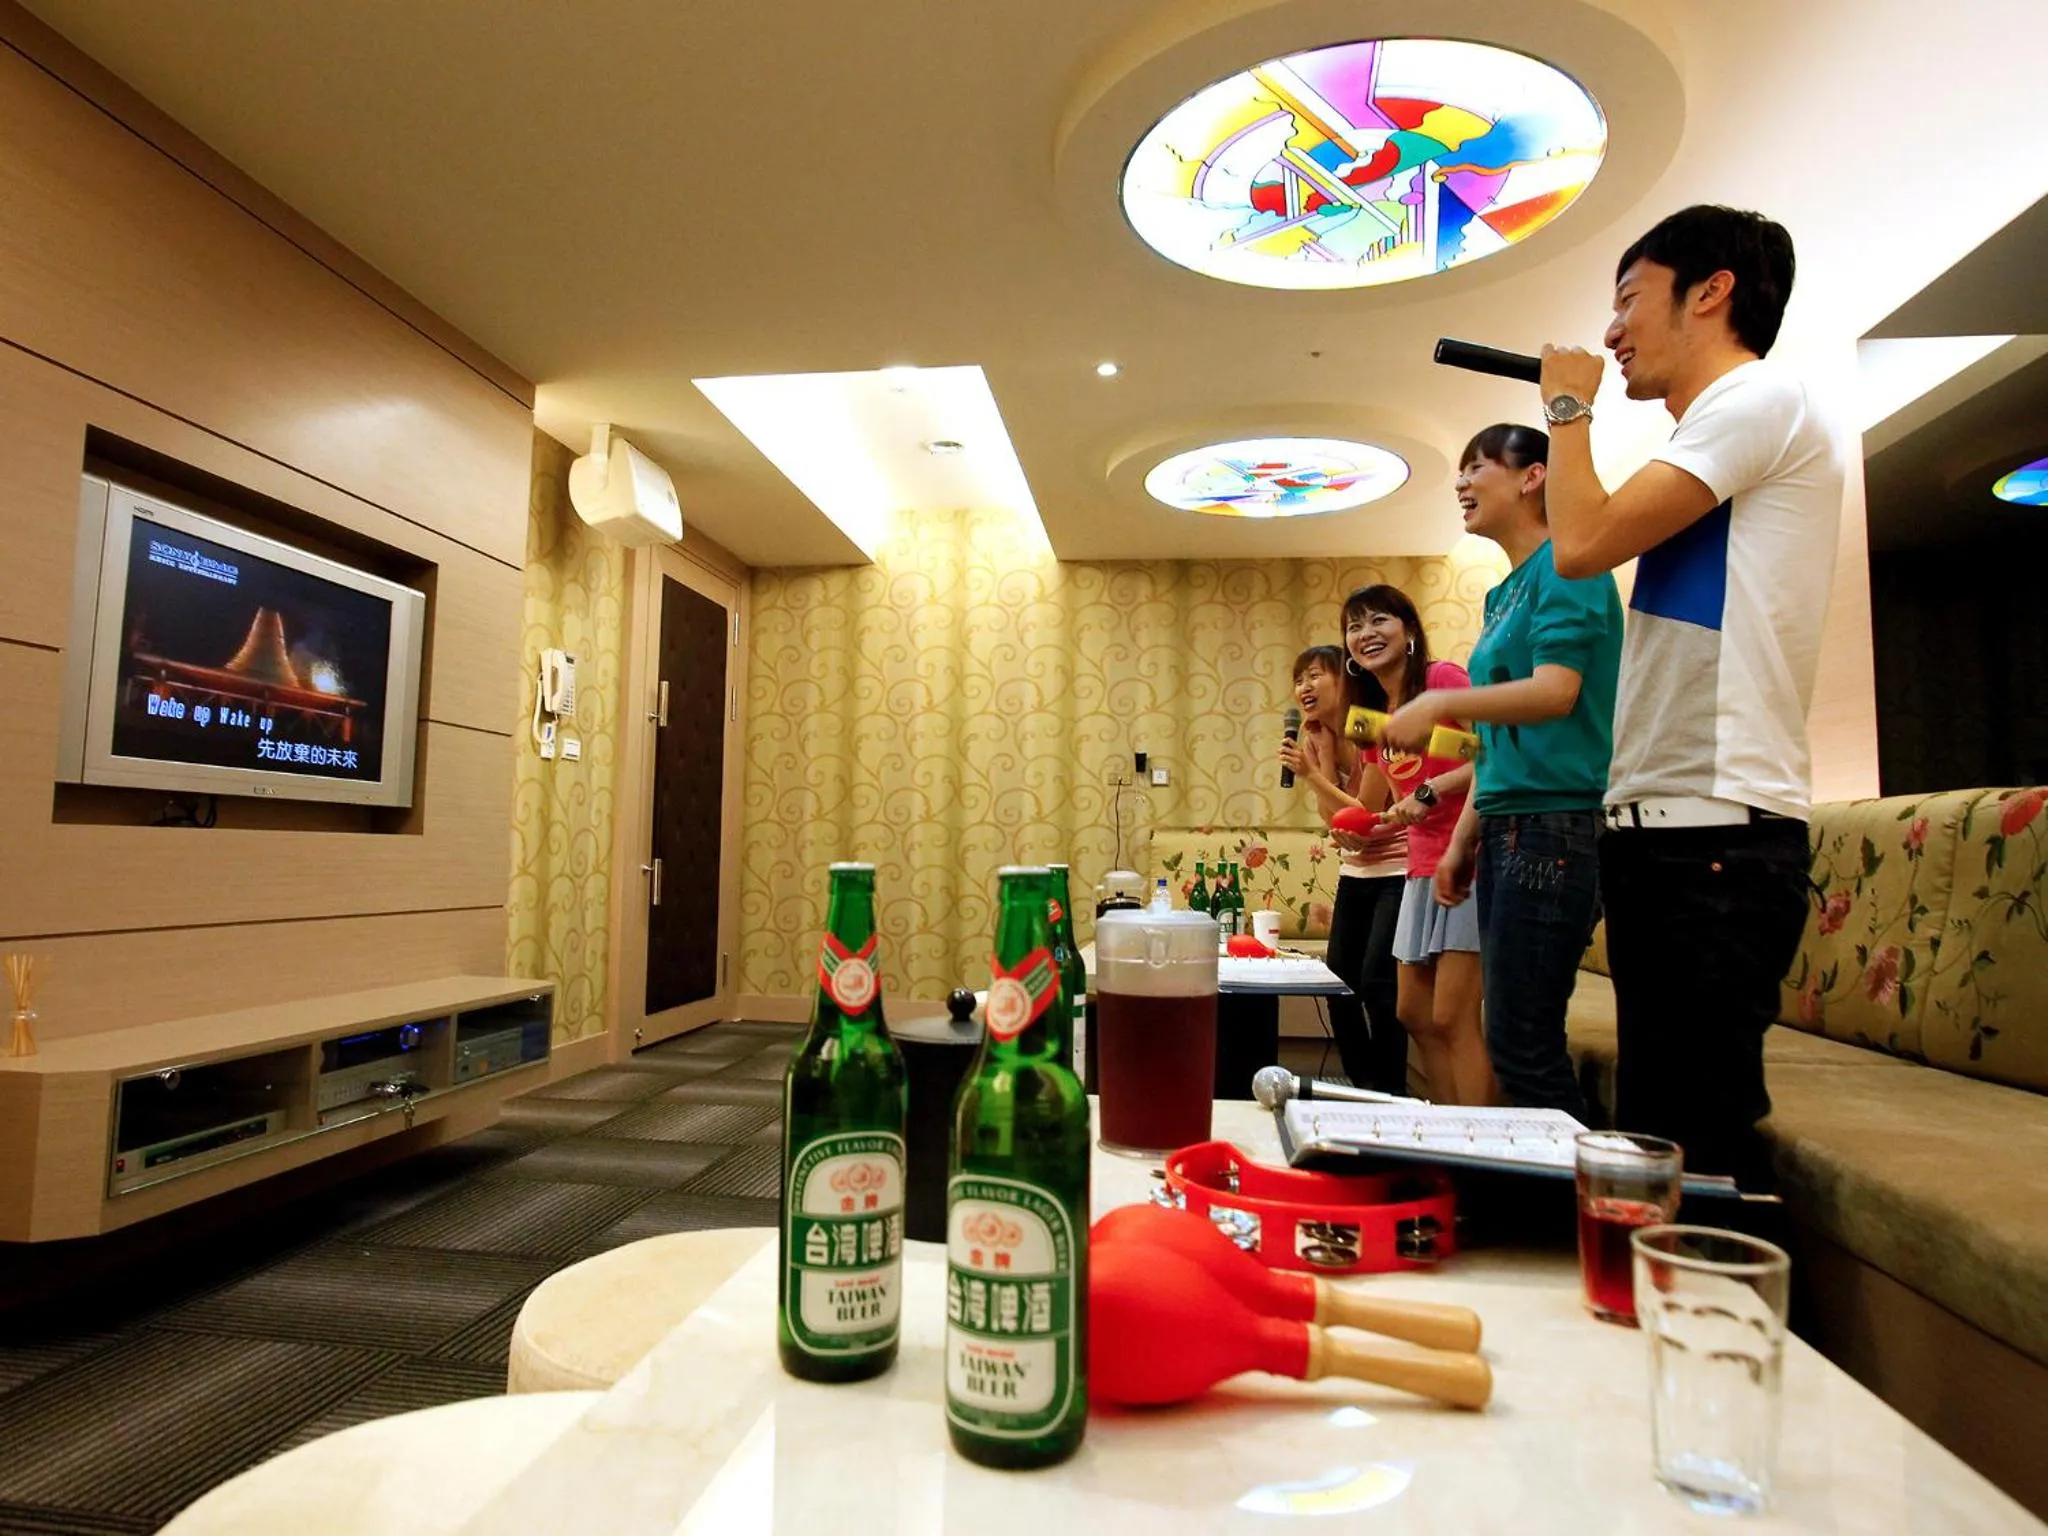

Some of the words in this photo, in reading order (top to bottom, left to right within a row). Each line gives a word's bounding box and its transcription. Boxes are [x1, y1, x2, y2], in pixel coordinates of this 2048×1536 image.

[148, 693, 186, 719] Wake
[219, 706, 251, 728] Wake
[260, 716, 273, 735] up
[257, 738, 358, 769] 先放棄的未來
[827, 1284, 890, 1306] TAIWAN
[836, 1302, 881, 1322] BEER
[959, 1351, 1027, 1379] TAIWAN
[966, 1374, 1018, 1399] BEER
